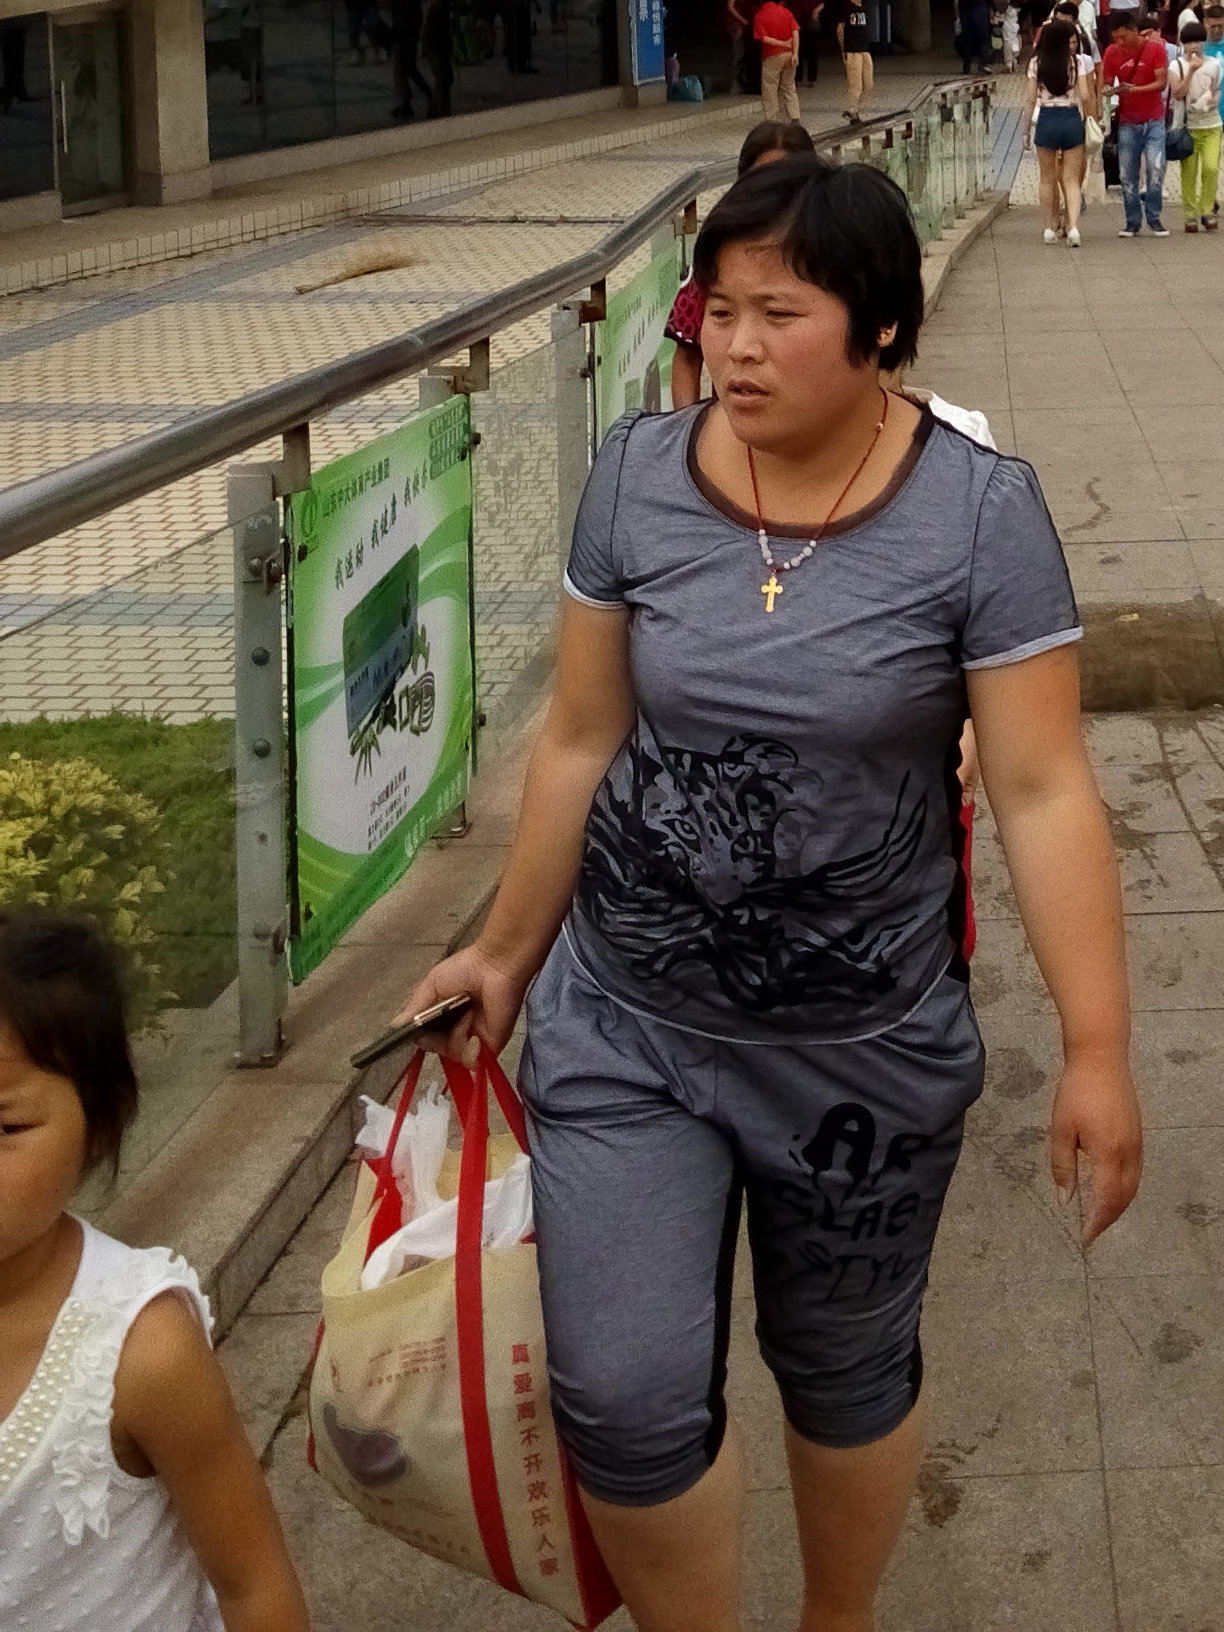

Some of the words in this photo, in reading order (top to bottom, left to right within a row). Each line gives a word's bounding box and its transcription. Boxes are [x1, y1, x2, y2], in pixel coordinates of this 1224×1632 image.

[334, 536, 365, 591] 我运动
[371, 491, 398, 551] 我健康
